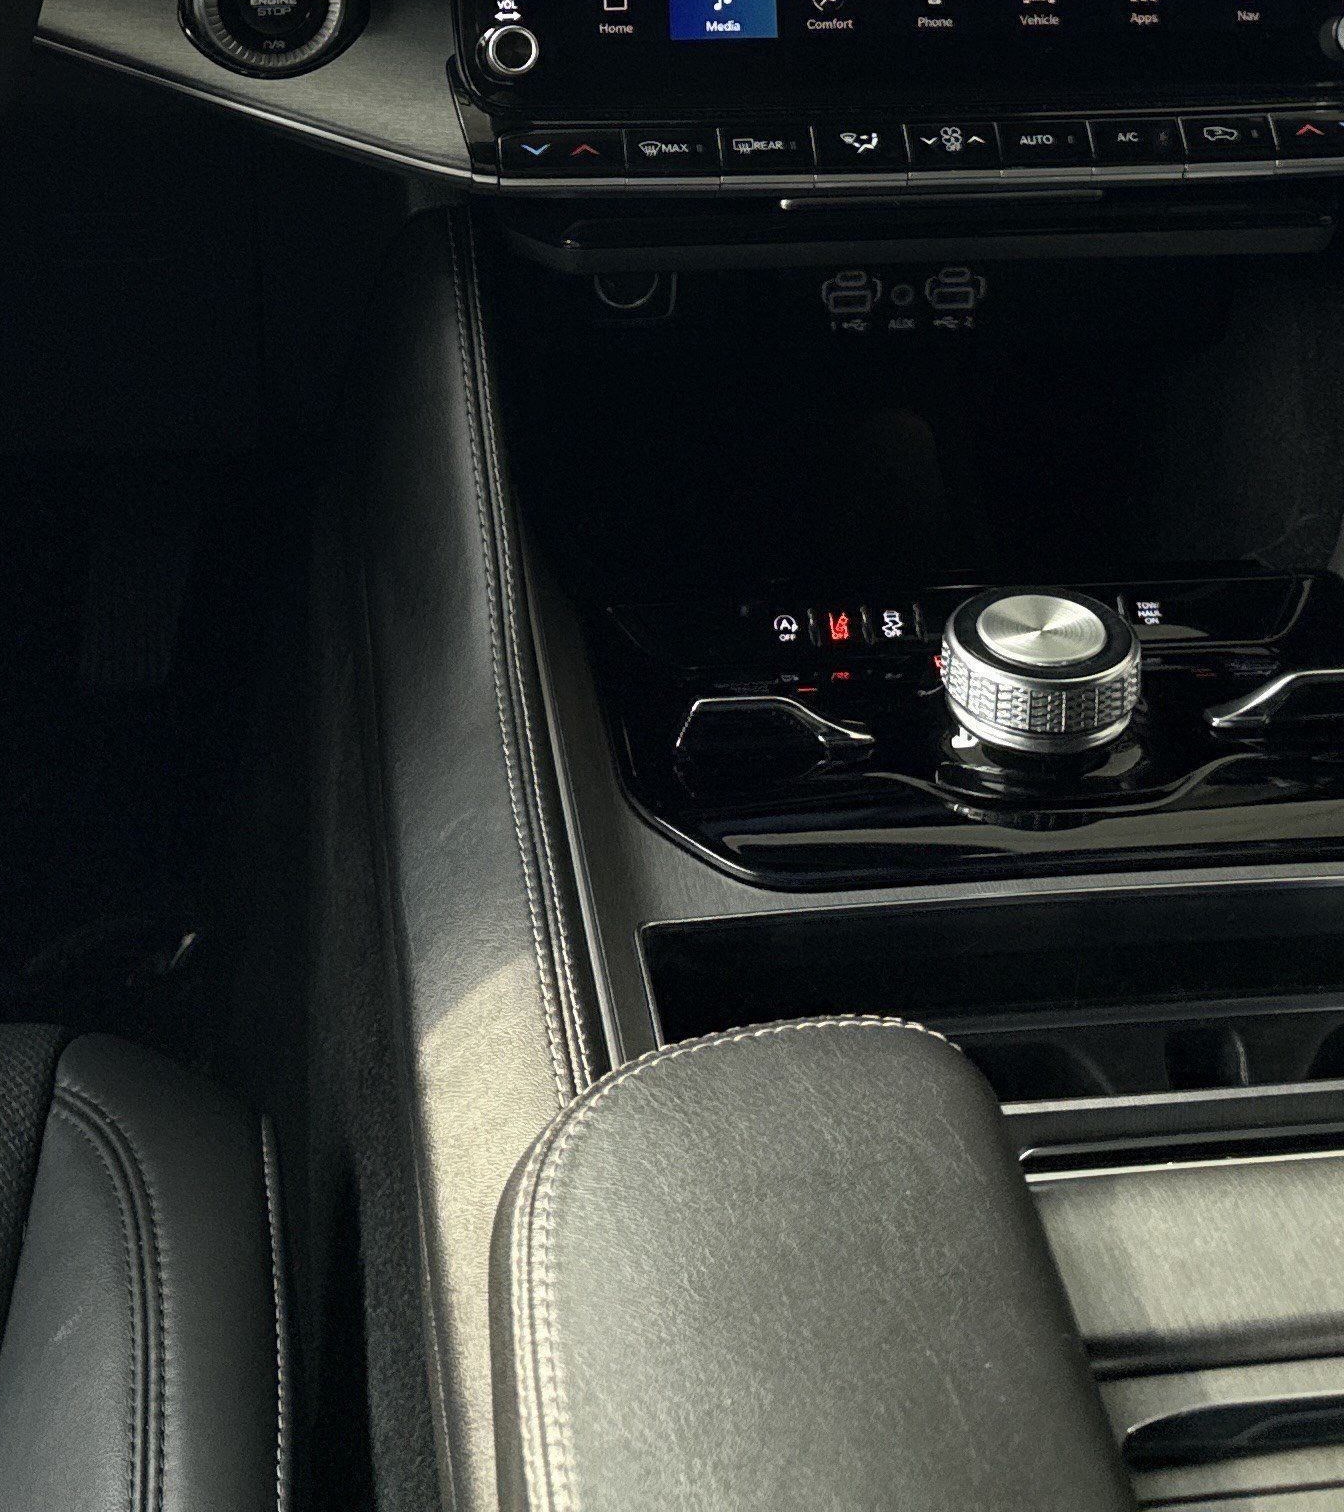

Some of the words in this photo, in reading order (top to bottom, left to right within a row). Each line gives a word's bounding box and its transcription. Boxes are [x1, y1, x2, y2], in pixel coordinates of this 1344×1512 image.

[497, 0, 517, 9] VOL
[257, 7, 292, 16] STOP
[1237, 10, 1261, 21] Nav
[806, 18, 854, 30] Comfort
[917, 16, 953, 27] Phone
[1020, 14, 1059, 26] Vehicle
[1130, 12, 1159, 25] Apps
[599, 23, 634, 34] Home
[705, 20, 741, 32] Media
[1019, 134, 1053, 146] AUTO
[1117, 131, 1139, 143] A/C
[661, 143, 688, 153] MAX
[754, 140, 783, 151] REAR
[1144, 617, 1160, 625] ON
[778, 633, 797, 642] OFF
